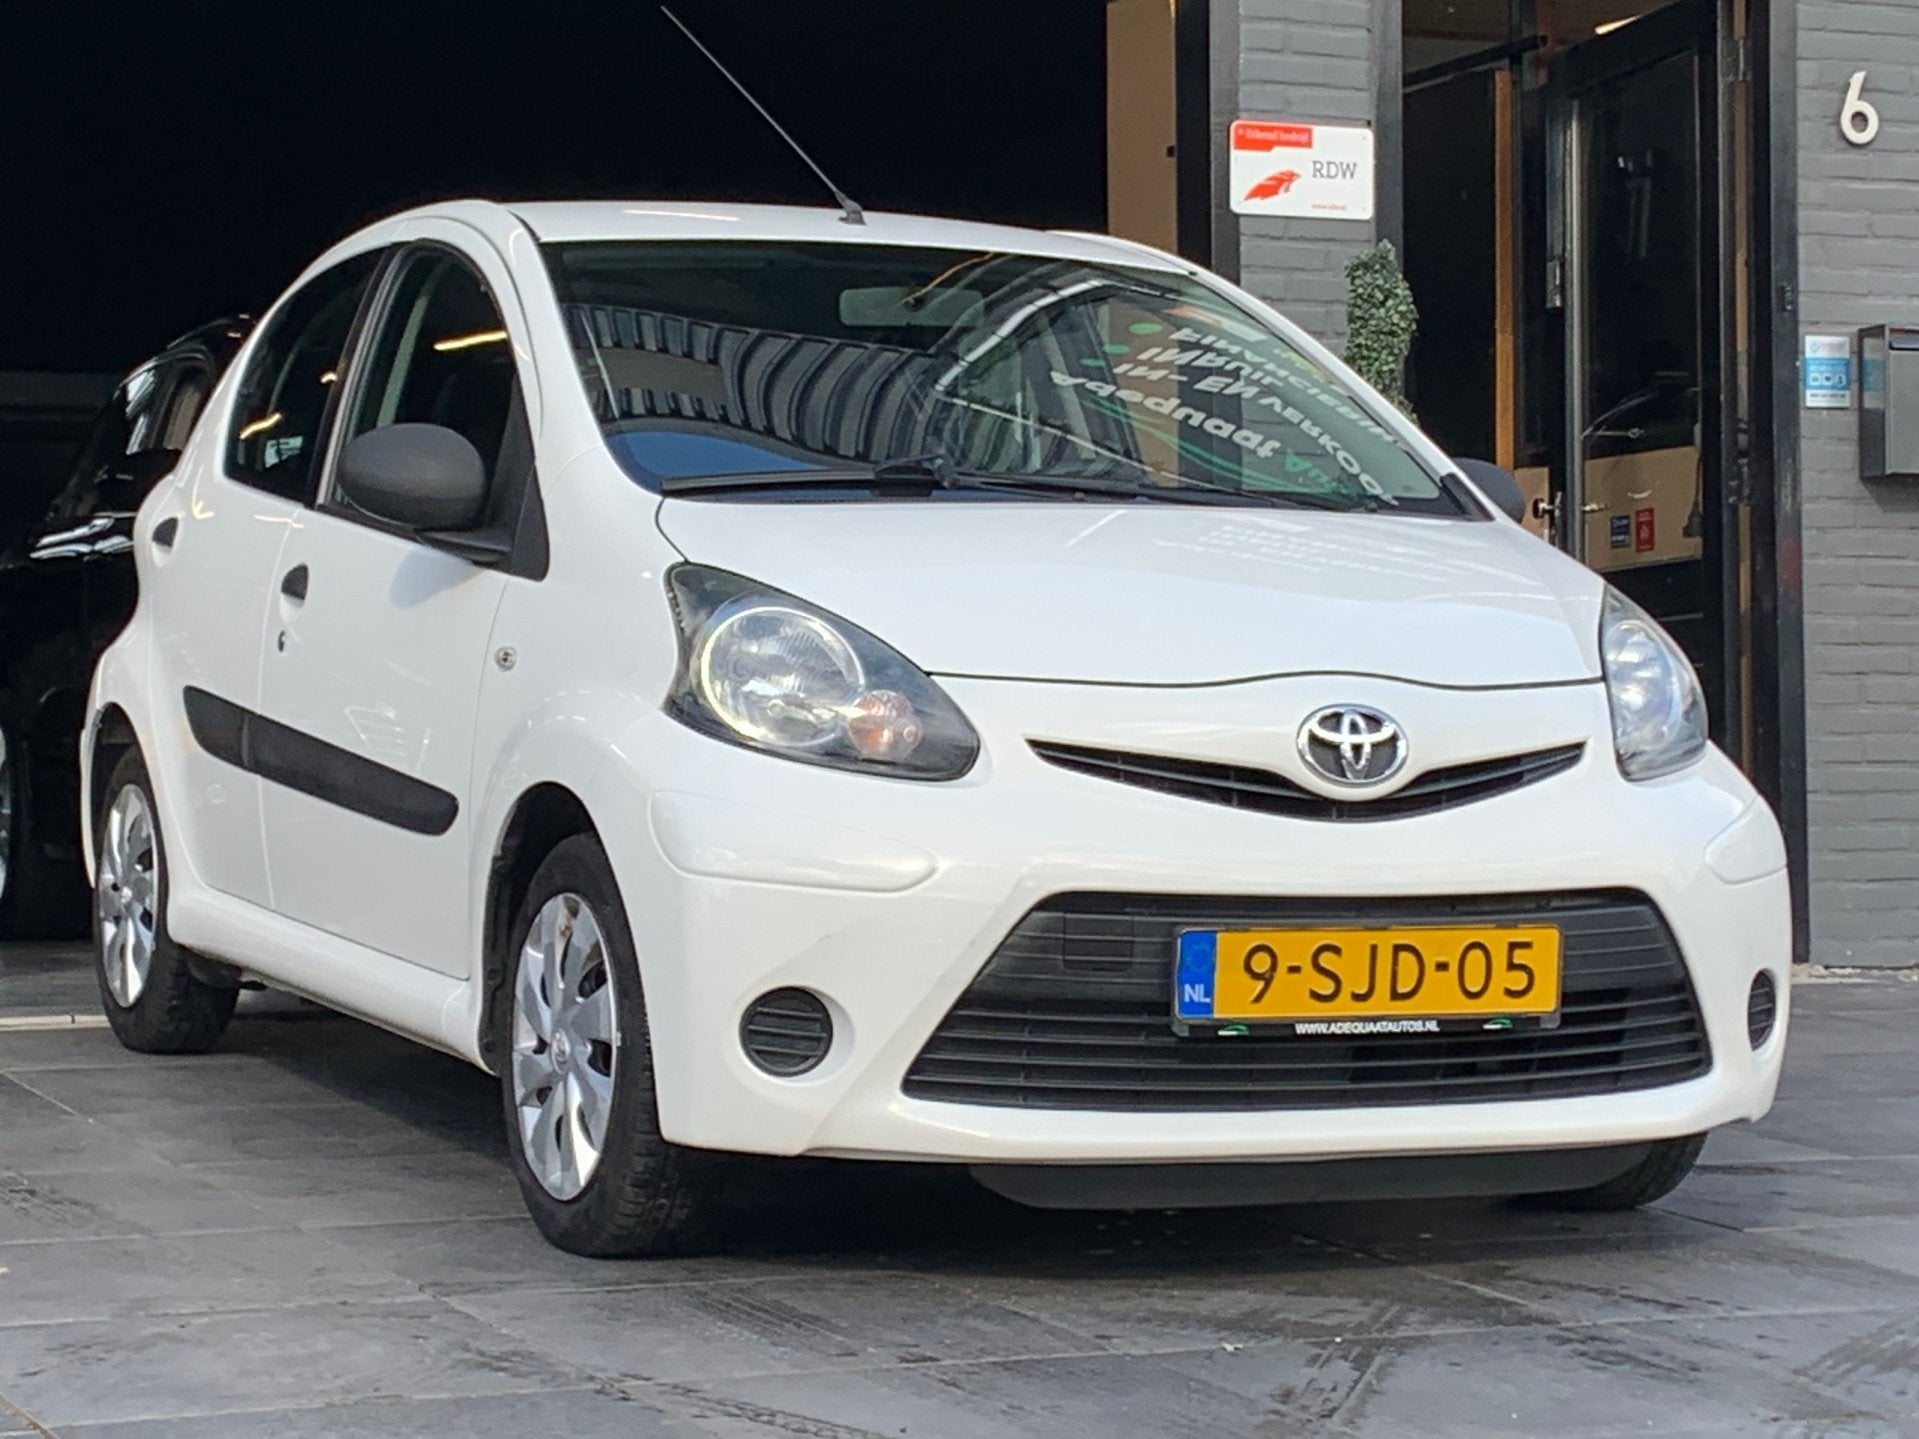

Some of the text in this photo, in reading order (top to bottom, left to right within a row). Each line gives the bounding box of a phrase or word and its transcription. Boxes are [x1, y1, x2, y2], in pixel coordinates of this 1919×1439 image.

[1840, 71, 1879, 145] 6
[1311, 160, 1358, 180] RDW
[1242, 941, 1535, 1004] 9-SJD-05
[1184, 983, 1211, 1003] NL
[1295, 1019, 1440, 1034] WWW.ADEQUAATAUTOS.NL
